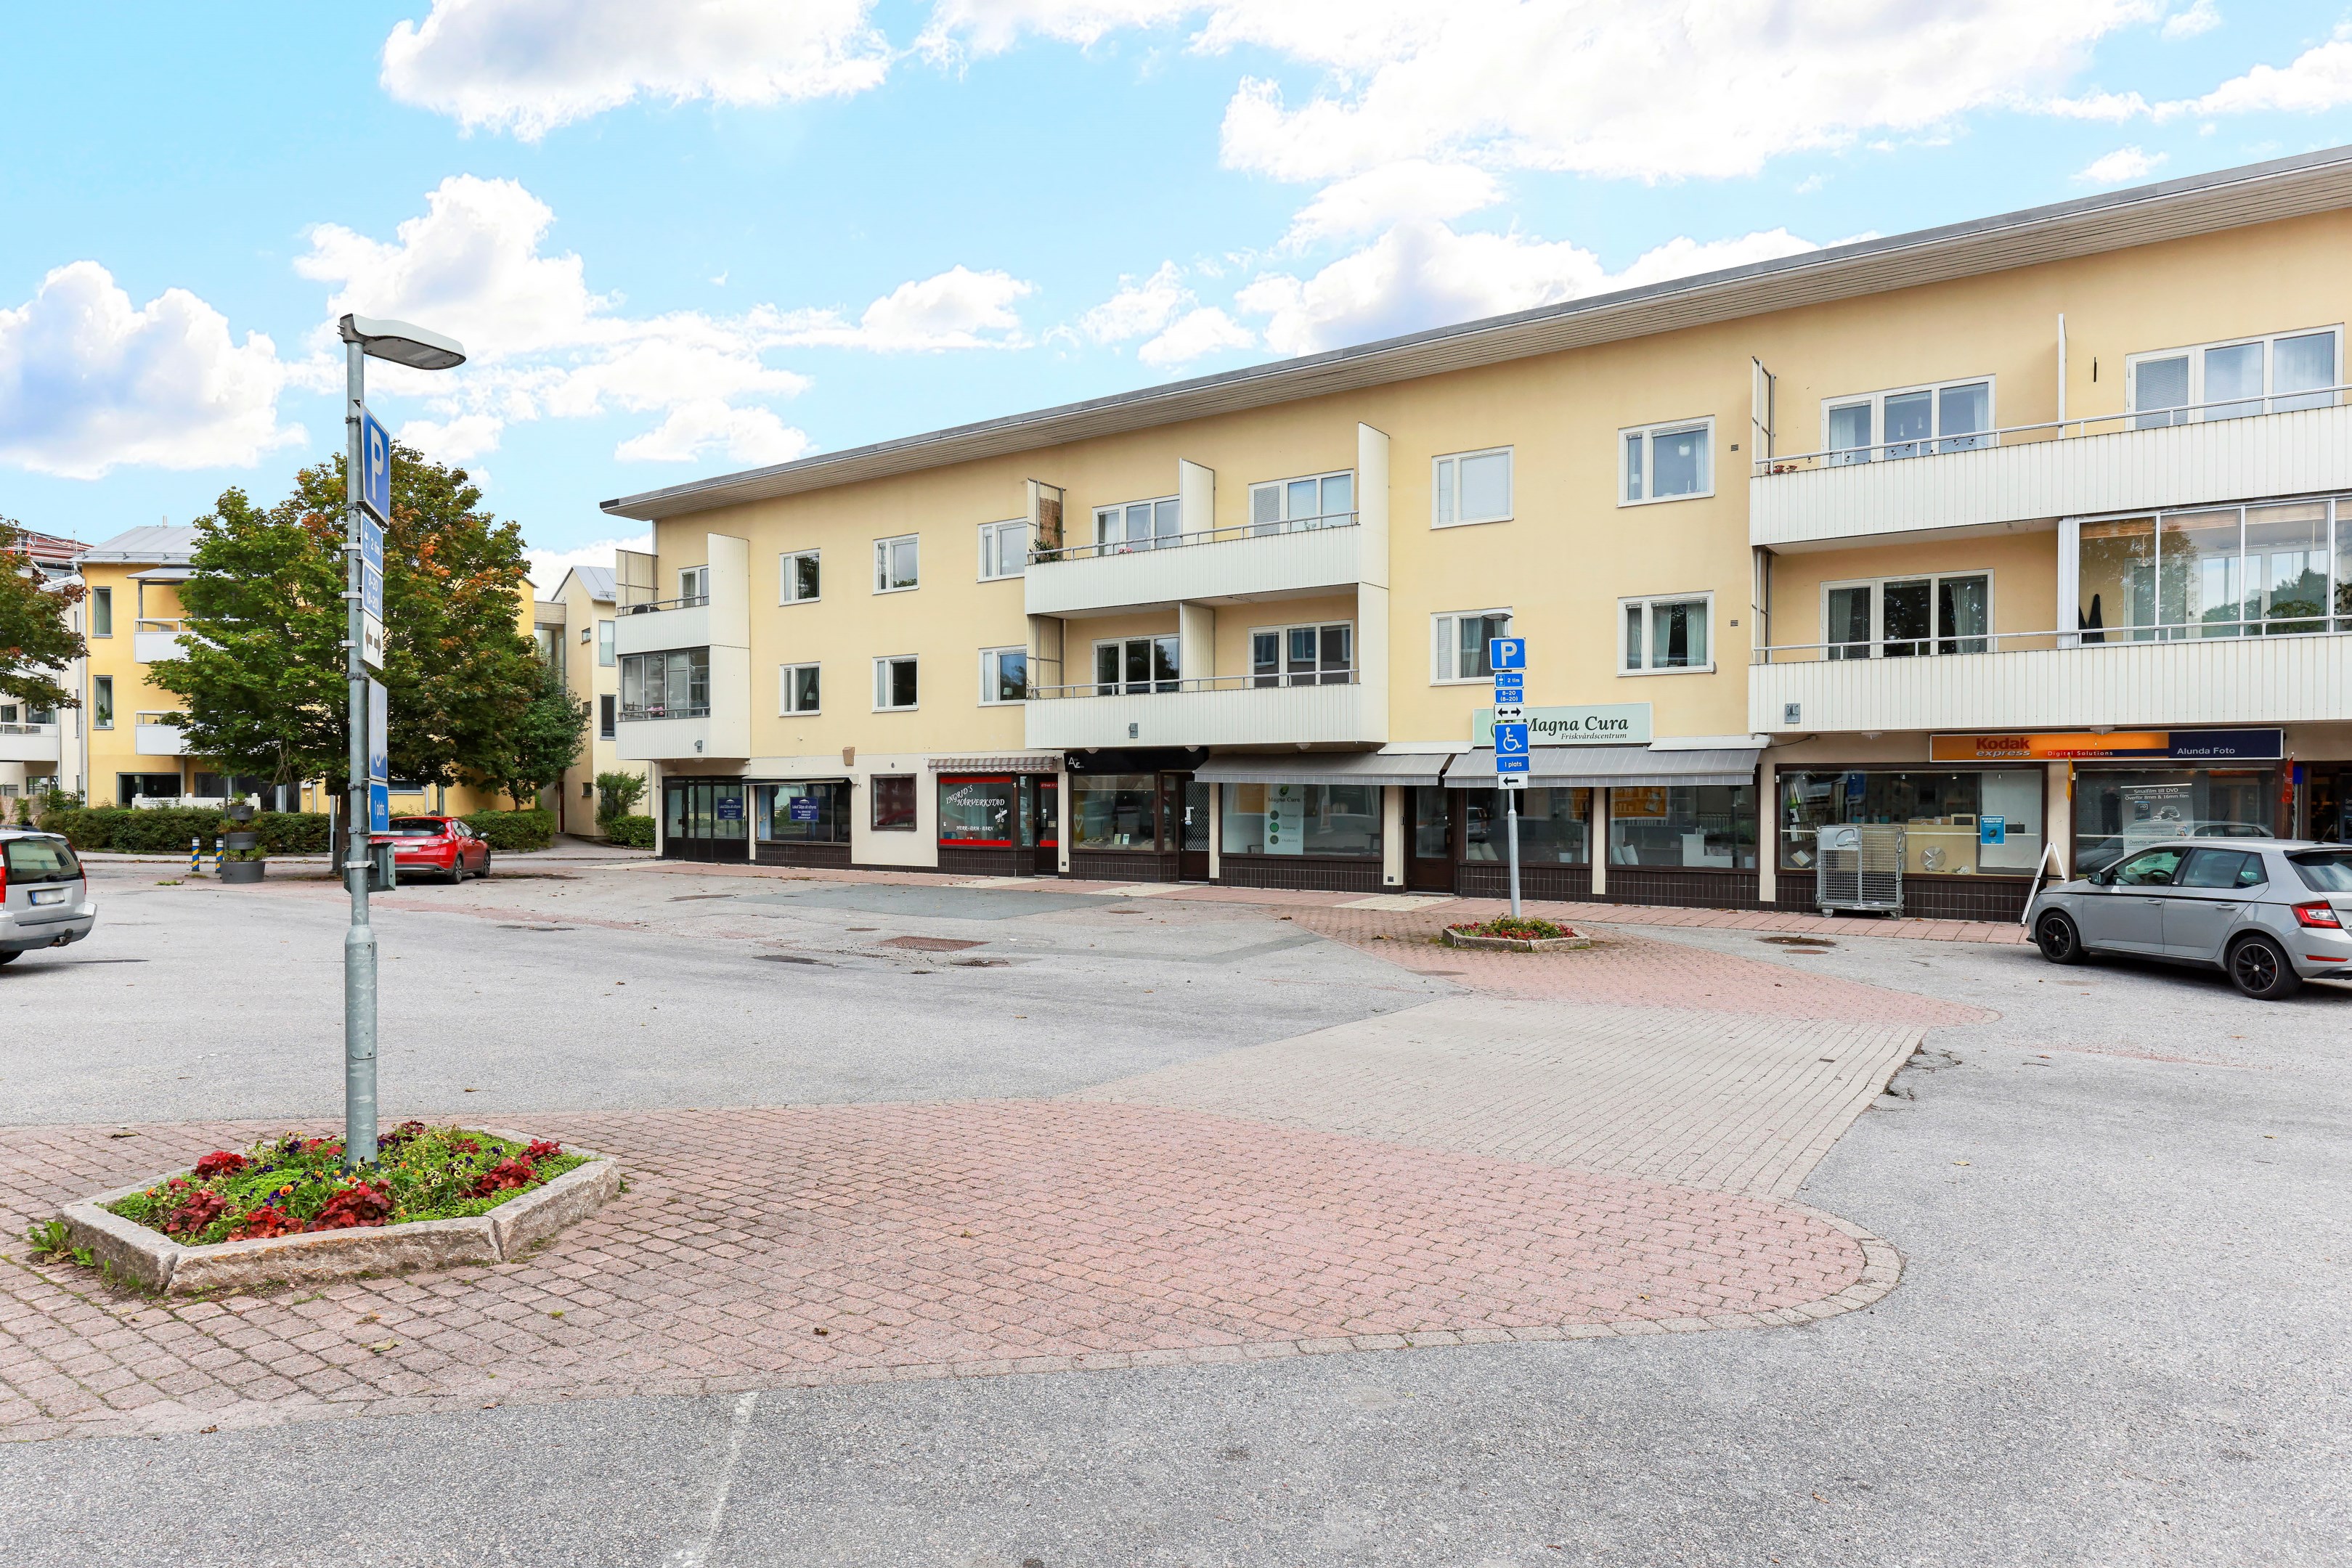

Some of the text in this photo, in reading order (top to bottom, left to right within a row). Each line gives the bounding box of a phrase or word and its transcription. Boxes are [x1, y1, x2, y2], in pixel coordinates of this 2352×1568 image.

[370, 424, 384, 500] P
[370, 538, 374, 550] 2
[368, 573, 378, 592] 8-20
[367, 589, 378, 612] (8-20)
[1501, 642, 1517, 666] P
[1523, 716, 1629, 736] Magna Cura
[1976, 737, 2030, 750] Kodak
[374, 800, 377, 816] 1
